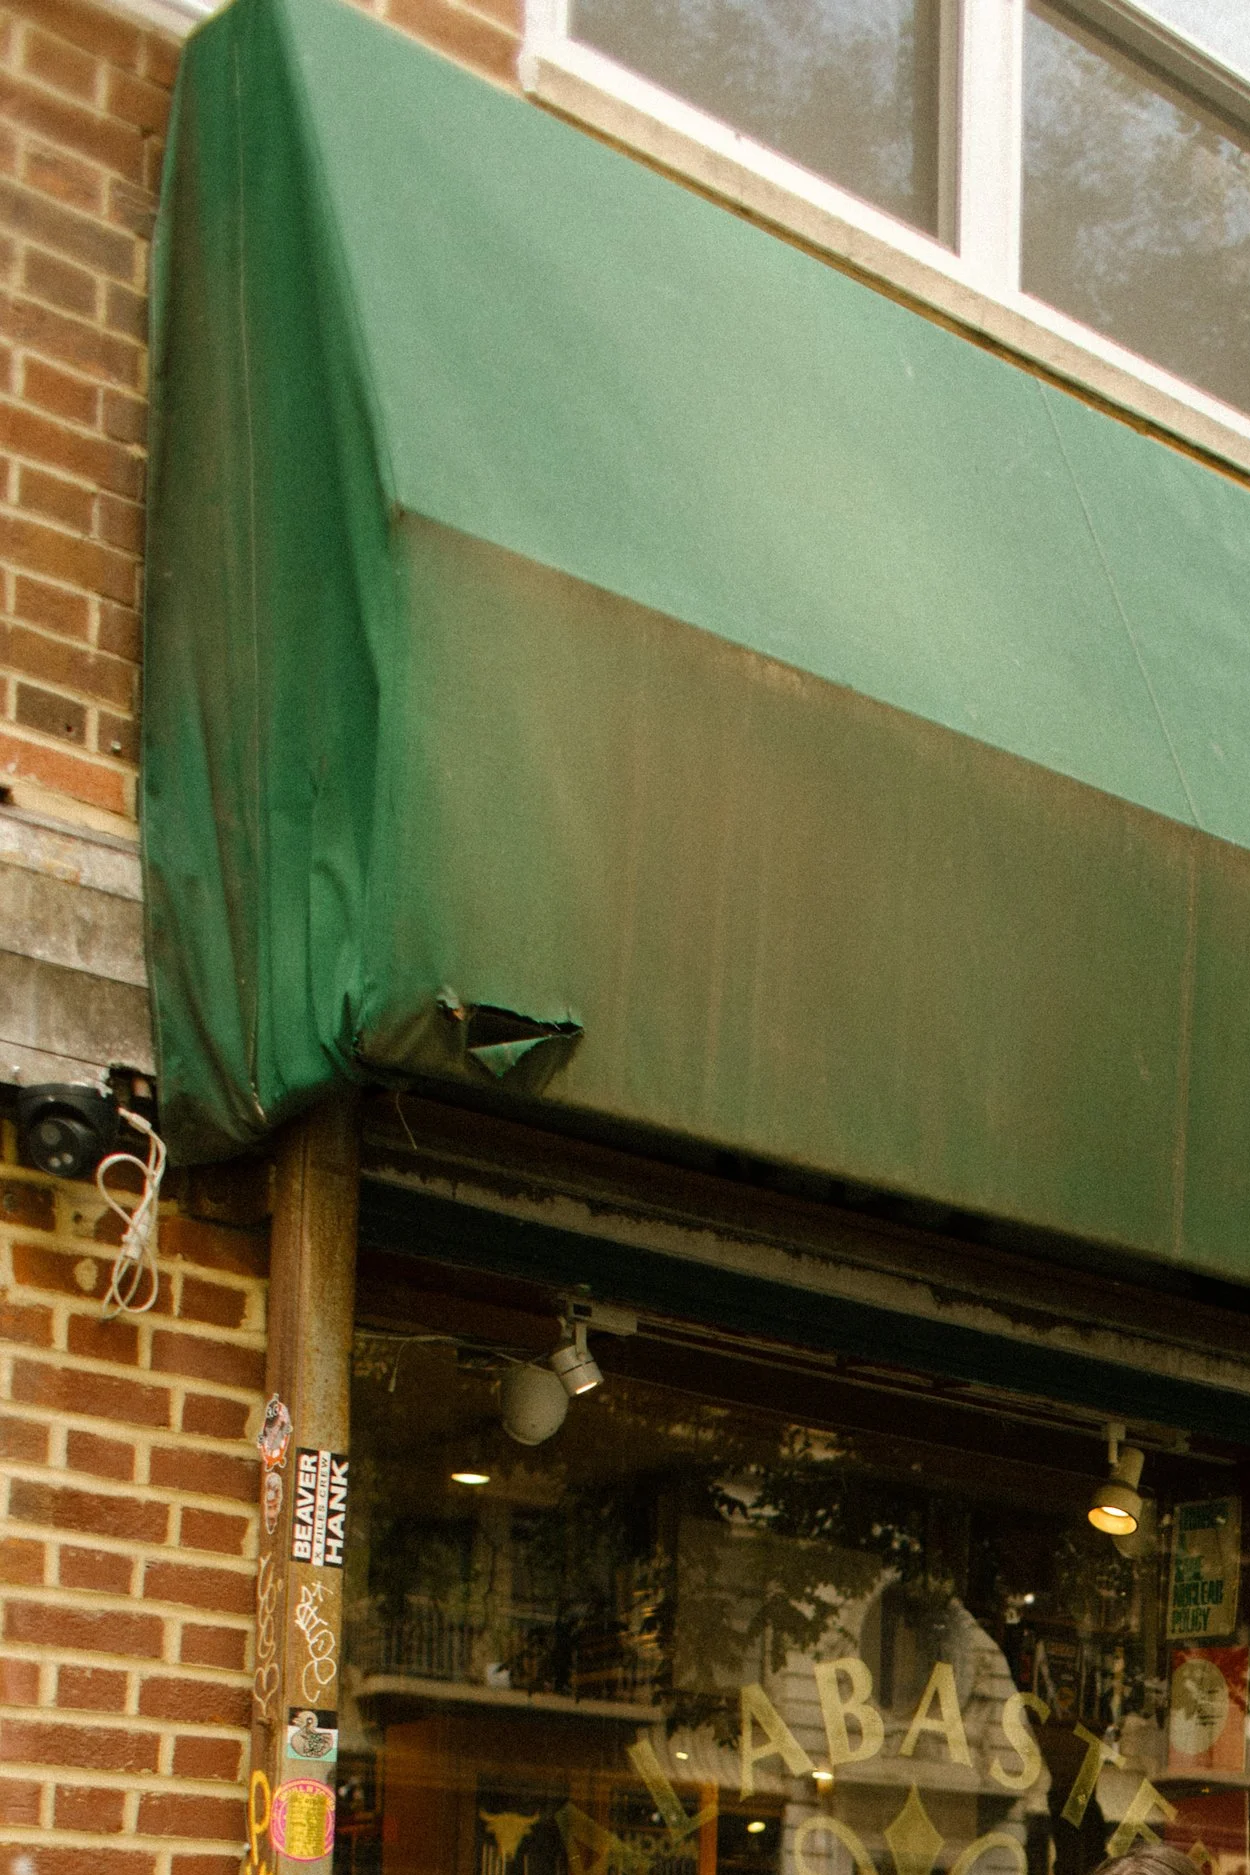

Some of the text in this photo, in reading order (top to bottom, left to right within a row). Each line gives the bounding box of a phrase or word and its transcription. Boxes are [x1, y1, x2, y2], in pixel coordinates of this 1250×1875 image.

[320, 1457, 328, 1498] CREW
[294, 1453, 319, 1559] BEAVER
[316, 1504, 326, 1545] FILES
[325, 1461, 349, 1565] HANK
[1171, 1606, 1211, 1634] POLICY
